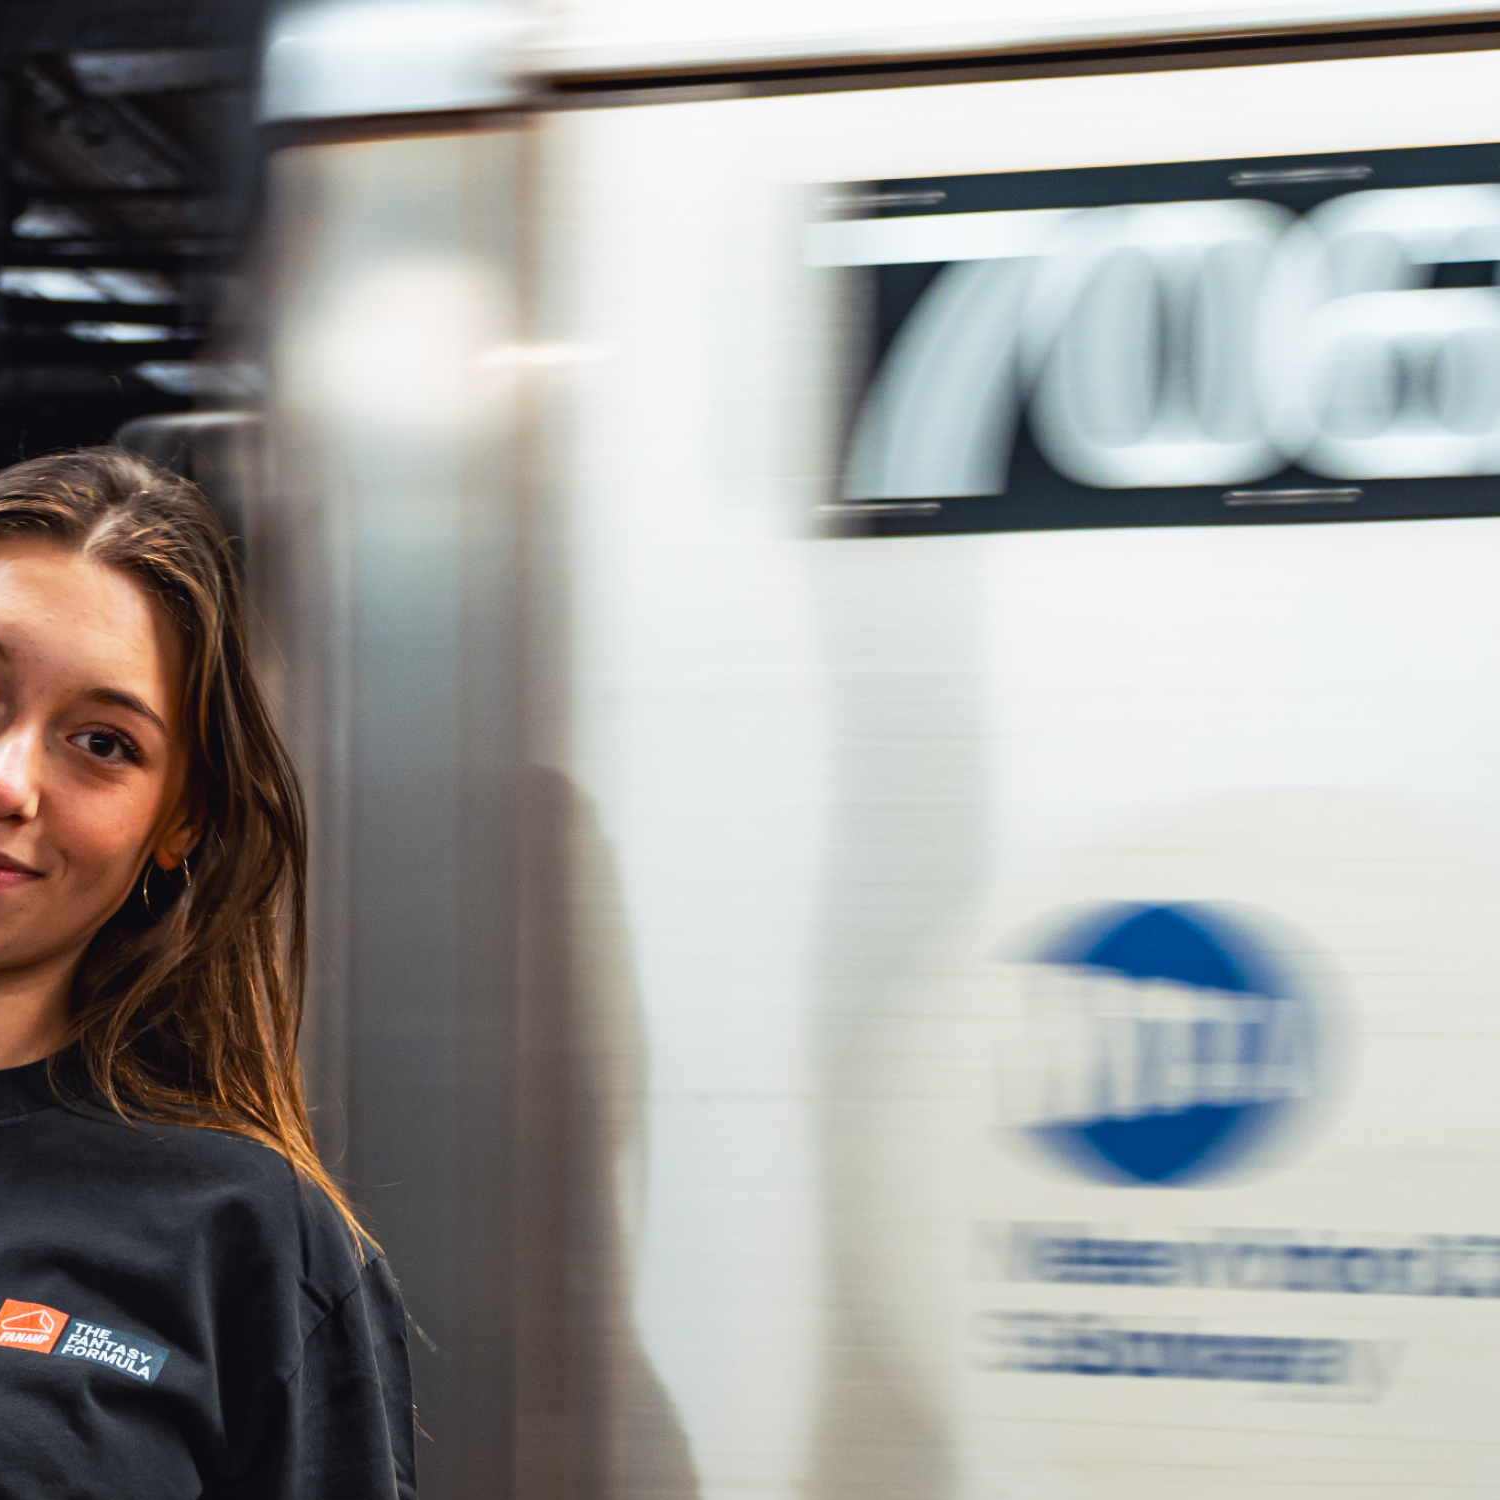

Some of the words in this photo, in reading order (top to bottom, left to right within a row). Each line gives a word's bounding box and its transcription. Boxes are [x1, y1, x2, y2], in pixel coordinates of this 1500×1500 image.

[74, 1322, 112, 1340] THE
[60, 1344, 151, 1381] FORMULA
[67, 1333, 153, 1364] FANTASY
